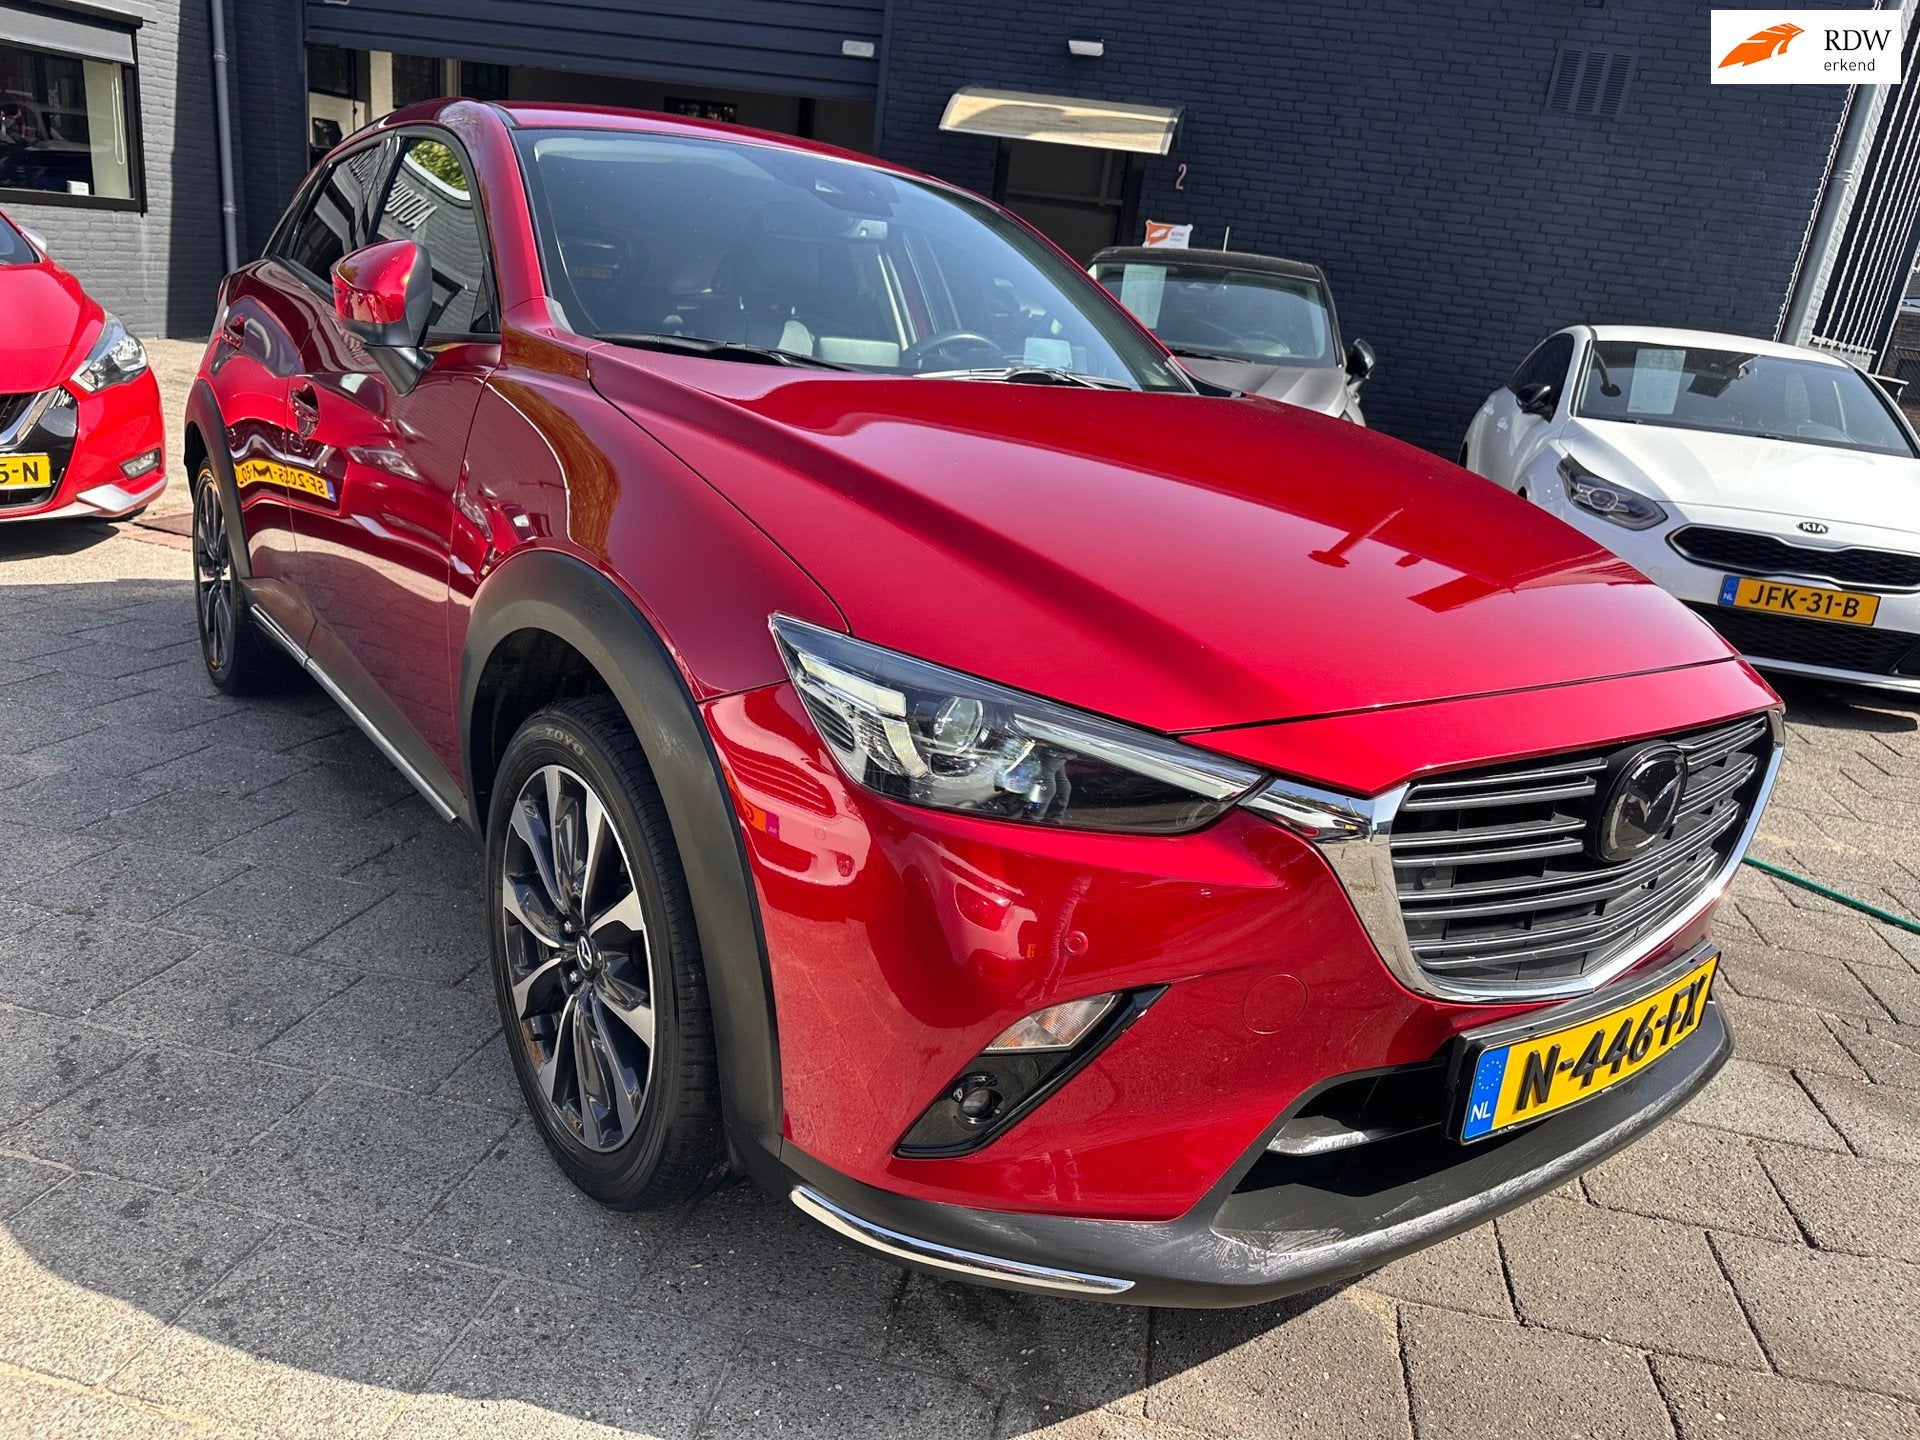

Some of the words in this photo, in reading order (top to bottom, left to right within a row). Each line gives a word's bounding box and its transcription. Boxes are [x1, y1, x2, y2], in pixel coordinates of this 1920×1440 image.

[1175, 163, 1188, 190] 2
[1802, 523, 1826, 533] KIA
[1722, 592, 1733, 601] NL
[1749, 585, 1860, 618] JFK-31-B
[545, 727, 585, 757] TOYO
[1513, 973, 1709, 1114] N-446-FX
[1470, 1100, 1492, 1123] NL
